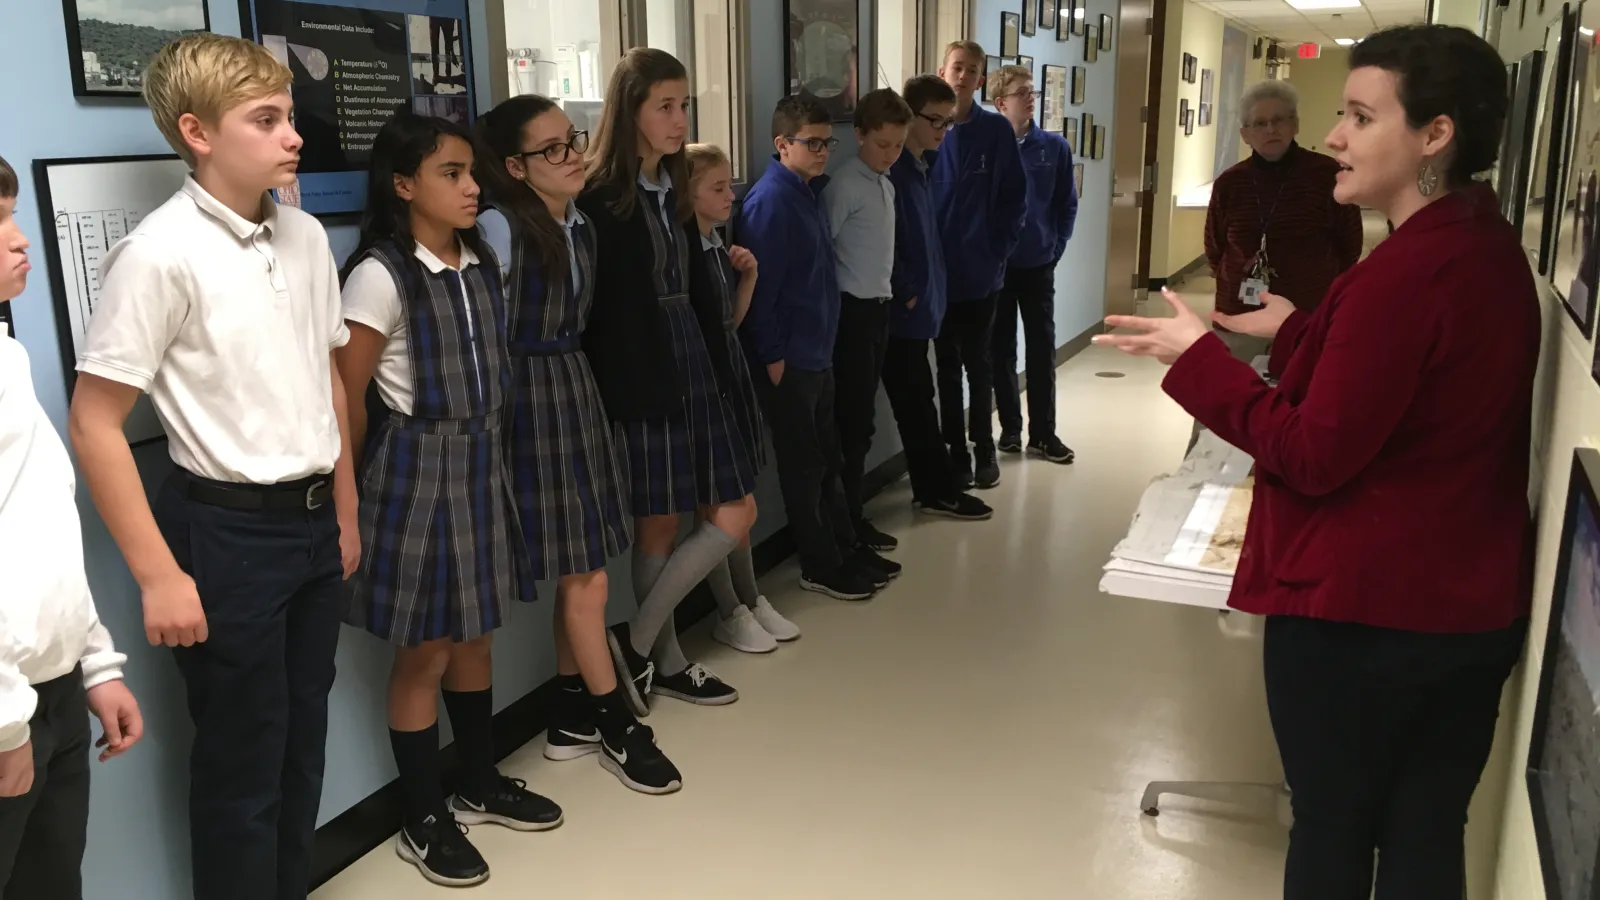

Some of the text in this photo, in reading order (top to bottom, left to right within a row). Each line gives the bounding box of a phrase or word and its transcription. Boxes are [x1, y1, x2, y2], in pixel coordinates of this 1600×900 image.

[301, 21, 341, 30] Environmental
[341, 60, 372, 68] Temperature
[374, 73, 400, 82] Chemistry
[344, 108, 372, 116] Vegetation
[372, 108, 394, 116] Changes
